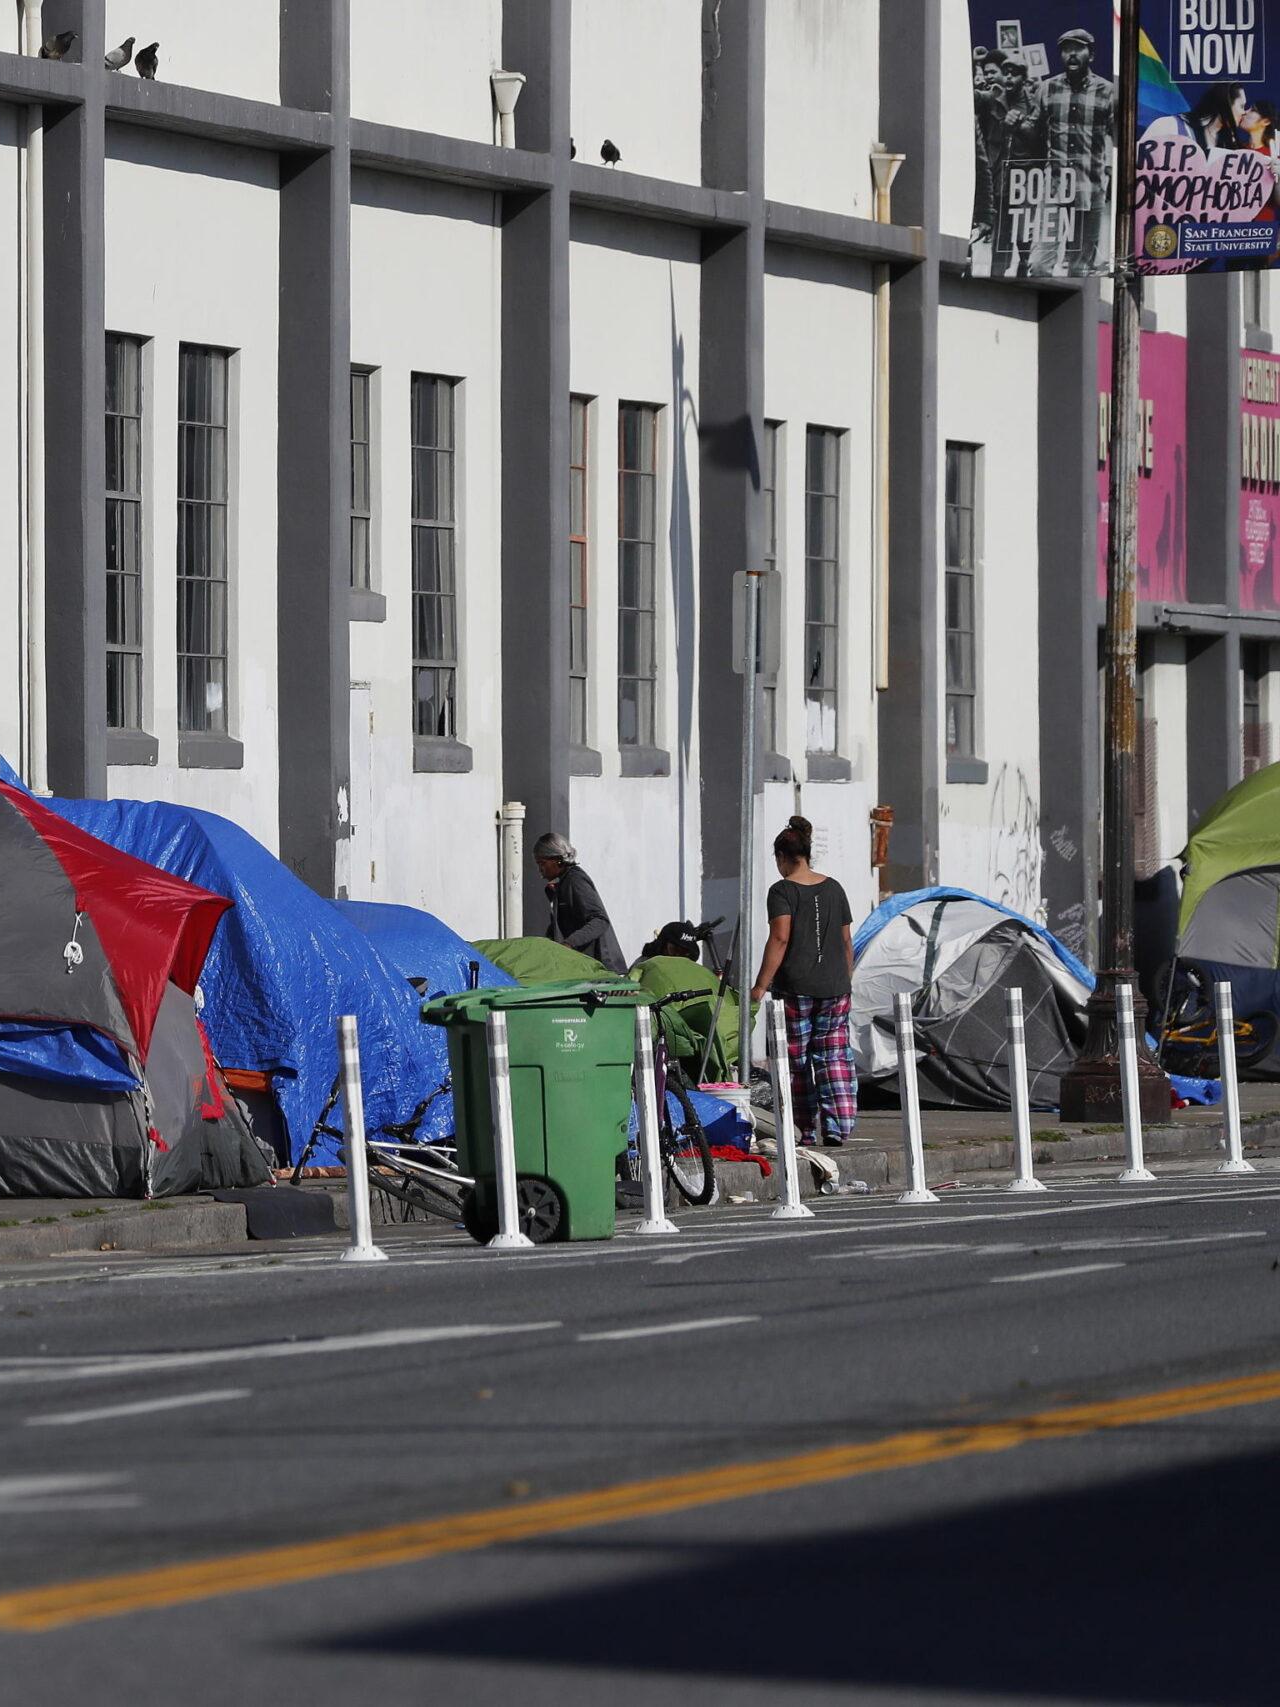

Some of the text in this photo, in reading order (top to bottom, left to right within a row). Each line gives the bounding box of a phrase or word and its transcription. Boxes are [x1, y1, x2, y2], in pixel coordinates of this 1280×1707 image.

[1179, 0, 1255, 31] BOLD
[1179, 33, 1255, 75] NOW
[1221, 153, 1264, 183] END
[1009, 167, 1077, 206] BOLD
[1135, 174, 1263, 212] OMOPHOBIA
[1008, 206, 1076, 243] THEN
[1211, 227, 1274, 238] FRANCISCO
[1185, 241, 1271, 252] STATE UNIVERSITY
